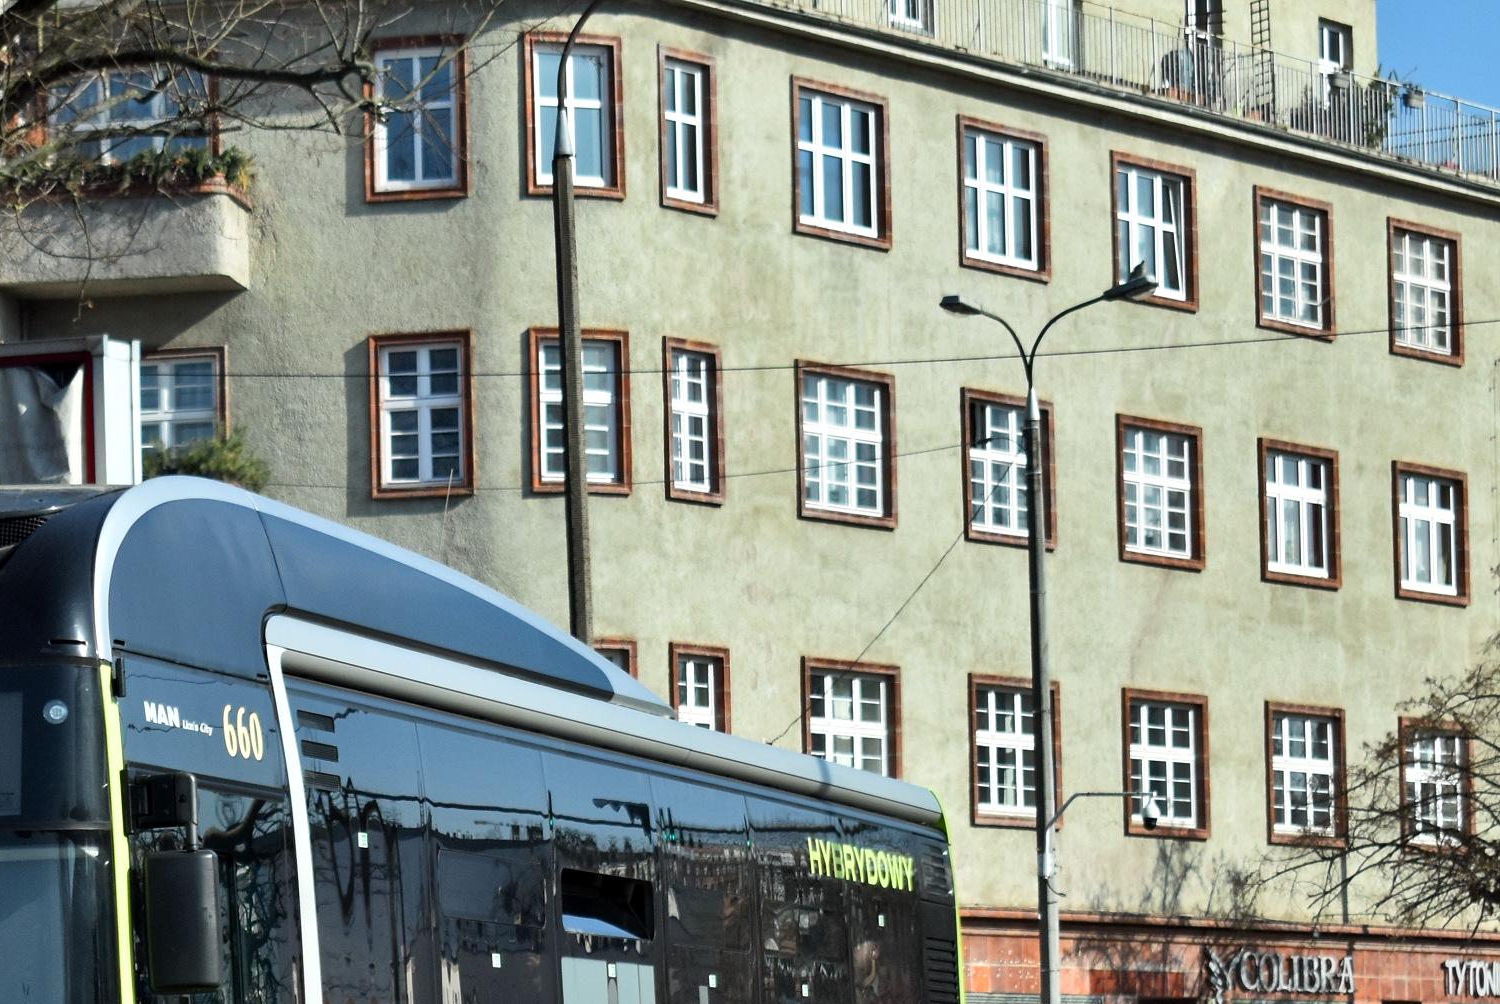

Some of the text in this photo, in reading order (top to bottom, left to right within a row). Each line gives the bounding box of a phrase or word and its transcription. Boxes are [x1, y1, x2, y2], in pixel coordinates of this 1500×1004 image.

[144, 701, 180, 728] MAN
[223, 704, 264, 761] 660
[807, 836, 913, 892] HYBRYDOWY
[1240, 950, 1355, 994] COLIBRA
